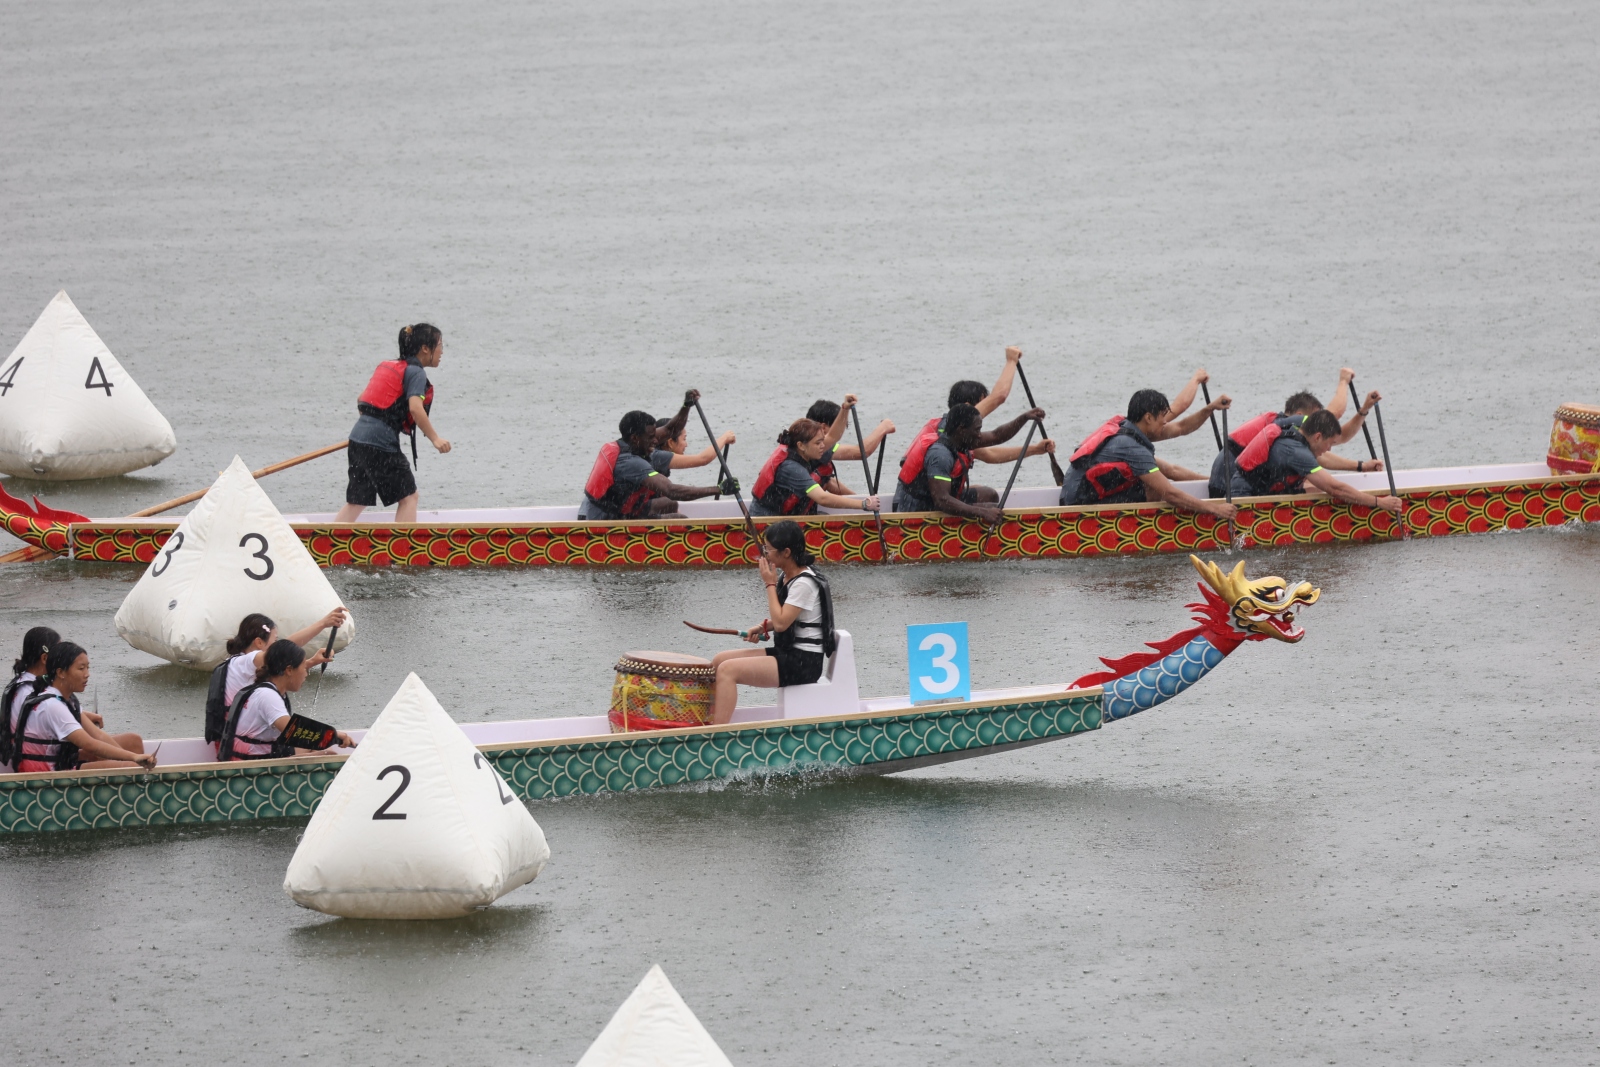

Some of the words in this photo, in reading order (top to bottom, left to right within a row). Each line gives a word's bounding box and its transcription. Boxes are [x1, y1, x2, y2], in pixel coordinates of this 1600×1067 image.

[0, 357, 25, 397] 4
[85, 357, 115, 397] 4
[152, 531, 185, 578] 3
[239, 533, 275, 581] 3
[918, 632, 960, 694] 3
[371, 764, 412, 821] 2
[473, 752, 515, 806] 2
